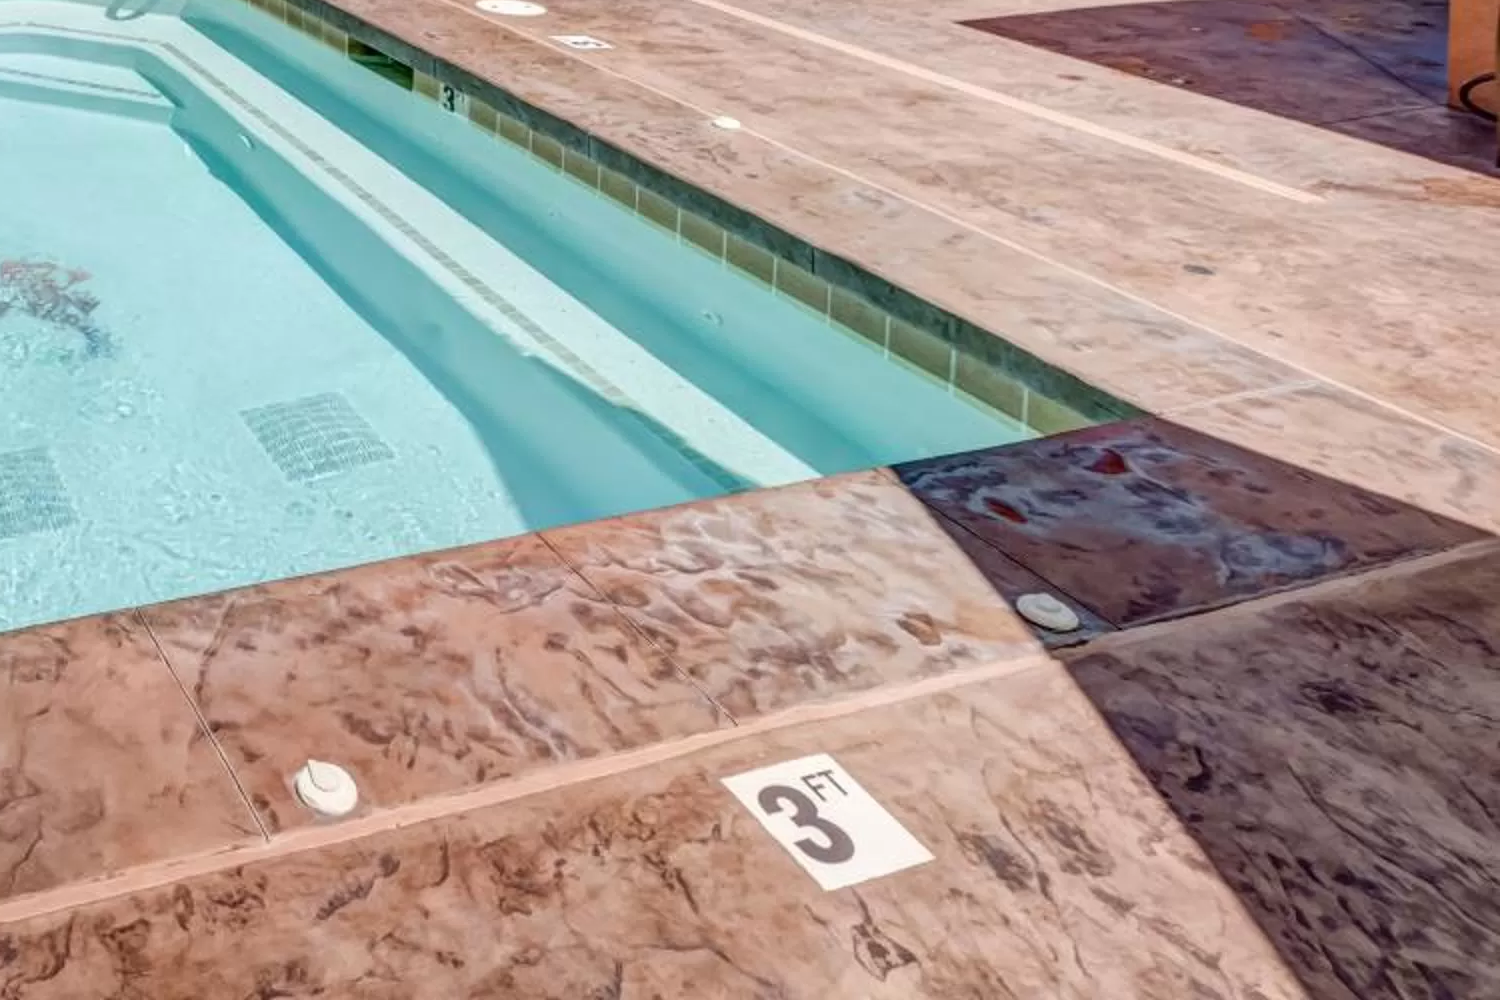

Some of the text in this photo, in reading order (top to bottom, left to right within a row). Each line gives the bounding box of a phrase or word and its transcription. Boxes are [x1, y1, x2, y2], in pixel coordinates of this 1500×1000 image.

[443, 86, 455, 112] 3
[757, 769, 856, 865] 3 FT
